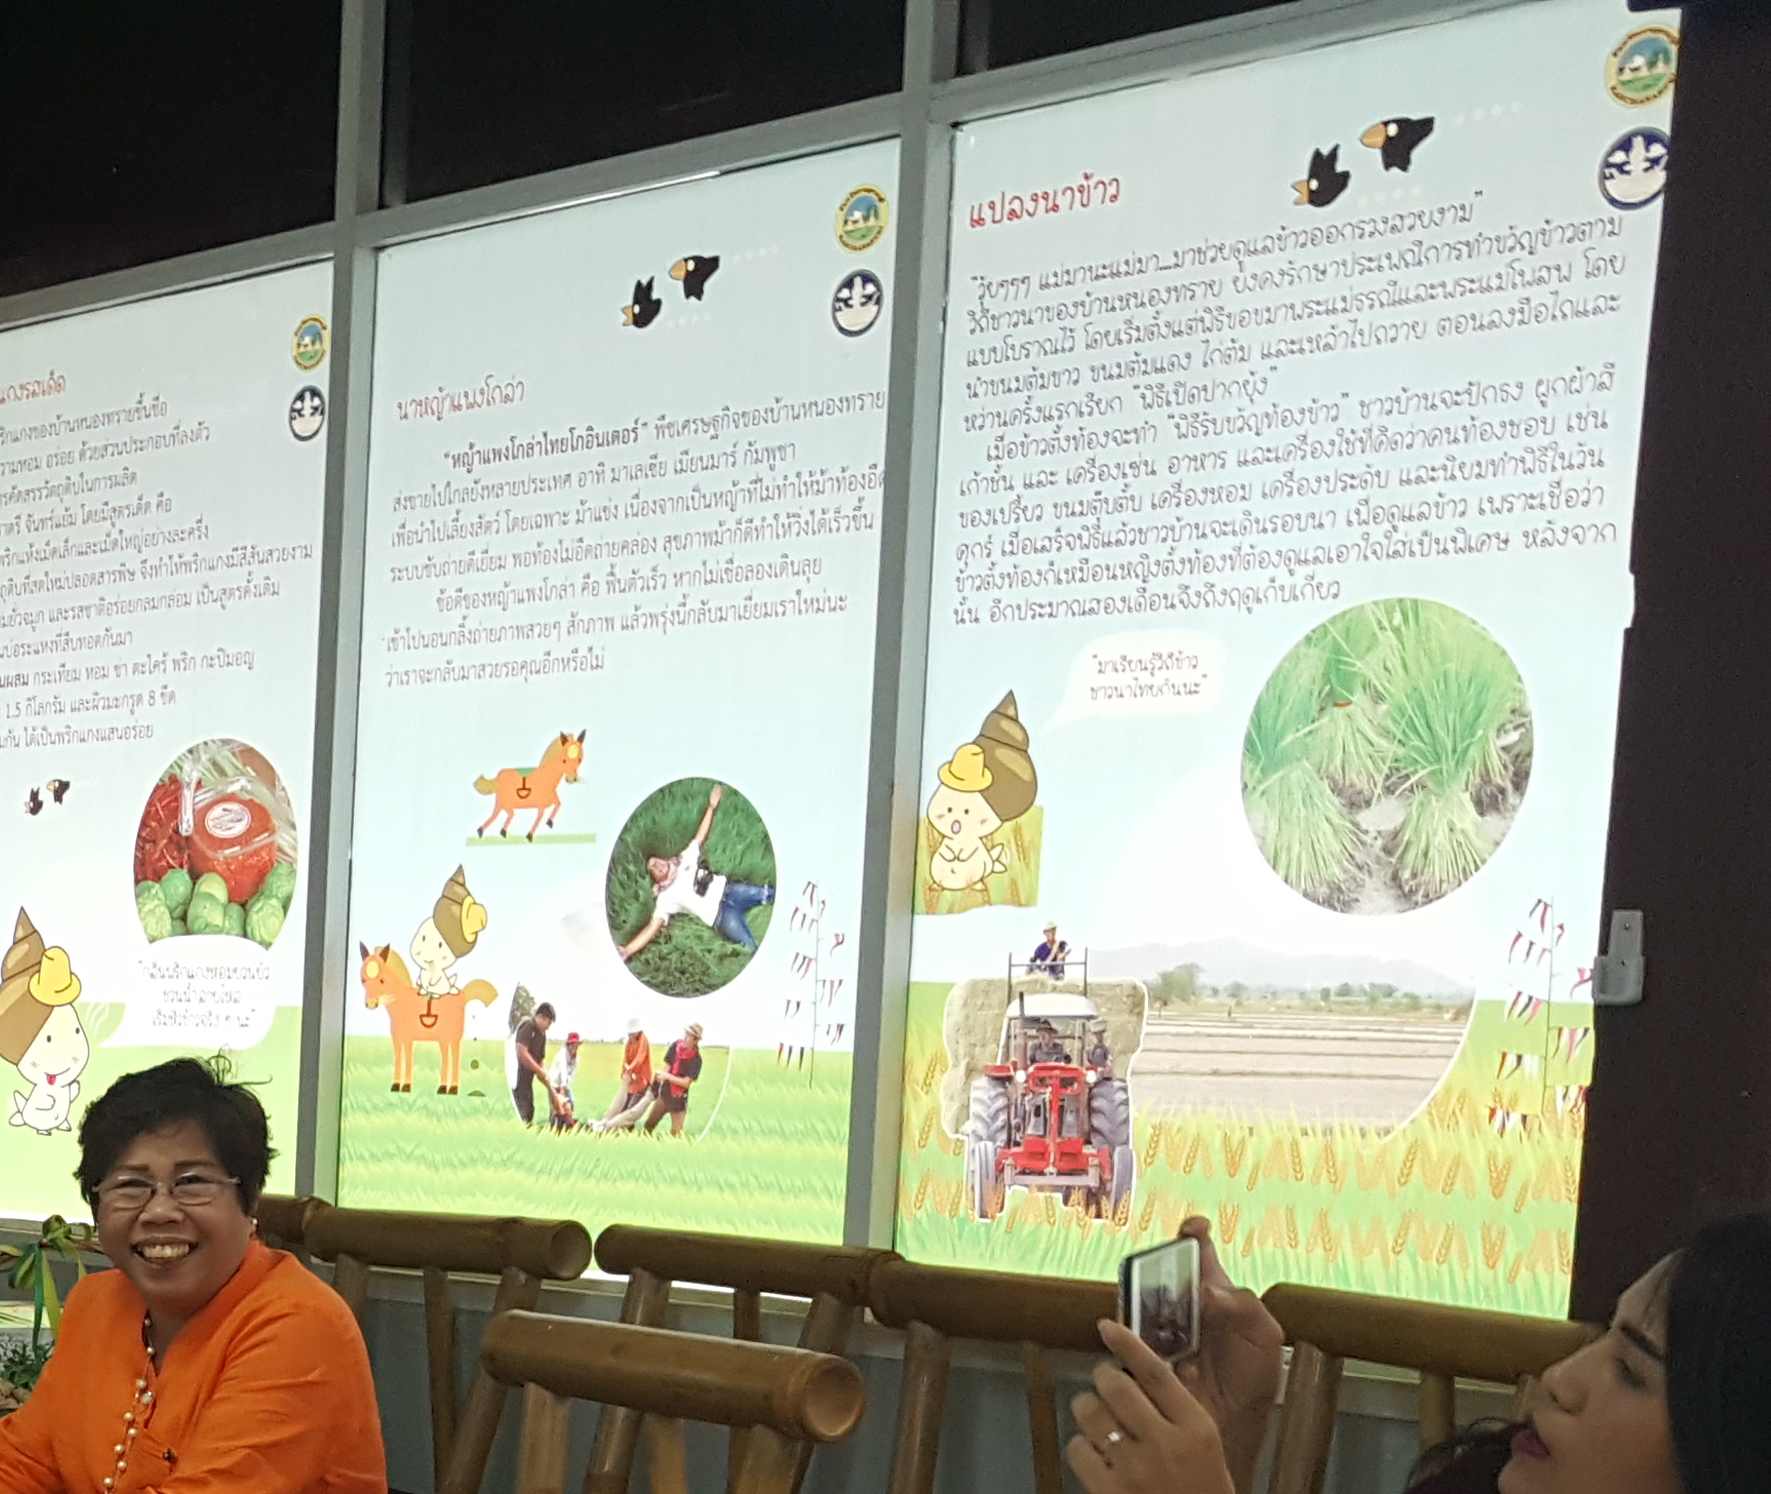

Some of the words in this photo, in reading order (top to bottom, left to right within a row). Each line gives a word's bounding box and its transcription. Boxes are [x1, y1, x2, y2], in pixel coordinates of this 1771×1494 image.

[969, 172, 1121, 229] แปลงนาข้าว
[966, 326, 1076, 368] แบบโบราณไว้
[1584, 246, 1625, 281] โดย
[1090, 348, 1192, 384] ขนมต้มแดง
[1201, 336, 1252, 370] ไก่ต้ม
[1023, 469, 1059, 490] และ
[1167, 449, 1228, 475] อาหาร
[1565, 404, 1609, 433] เช่น
[577, 462, 605, 489] อาทิ
[1150, 475, 1253, 512] เครื่องหอม
[505, 508, 570, 535] โดยเฉพาะ
[1523, 518, 1618, 549] หลังจาก
[580, 572, 600, 598] คือ
[33, 663, 80, 687] กระเทียม
[85, 662, 109, 681] หอม
[172, 650, 196, 672] พริก
[6, 703, 21, 718] 1.5
[25, 695, 66, 717] กิโลกรัม
[147, 691, 156, 706] 8
